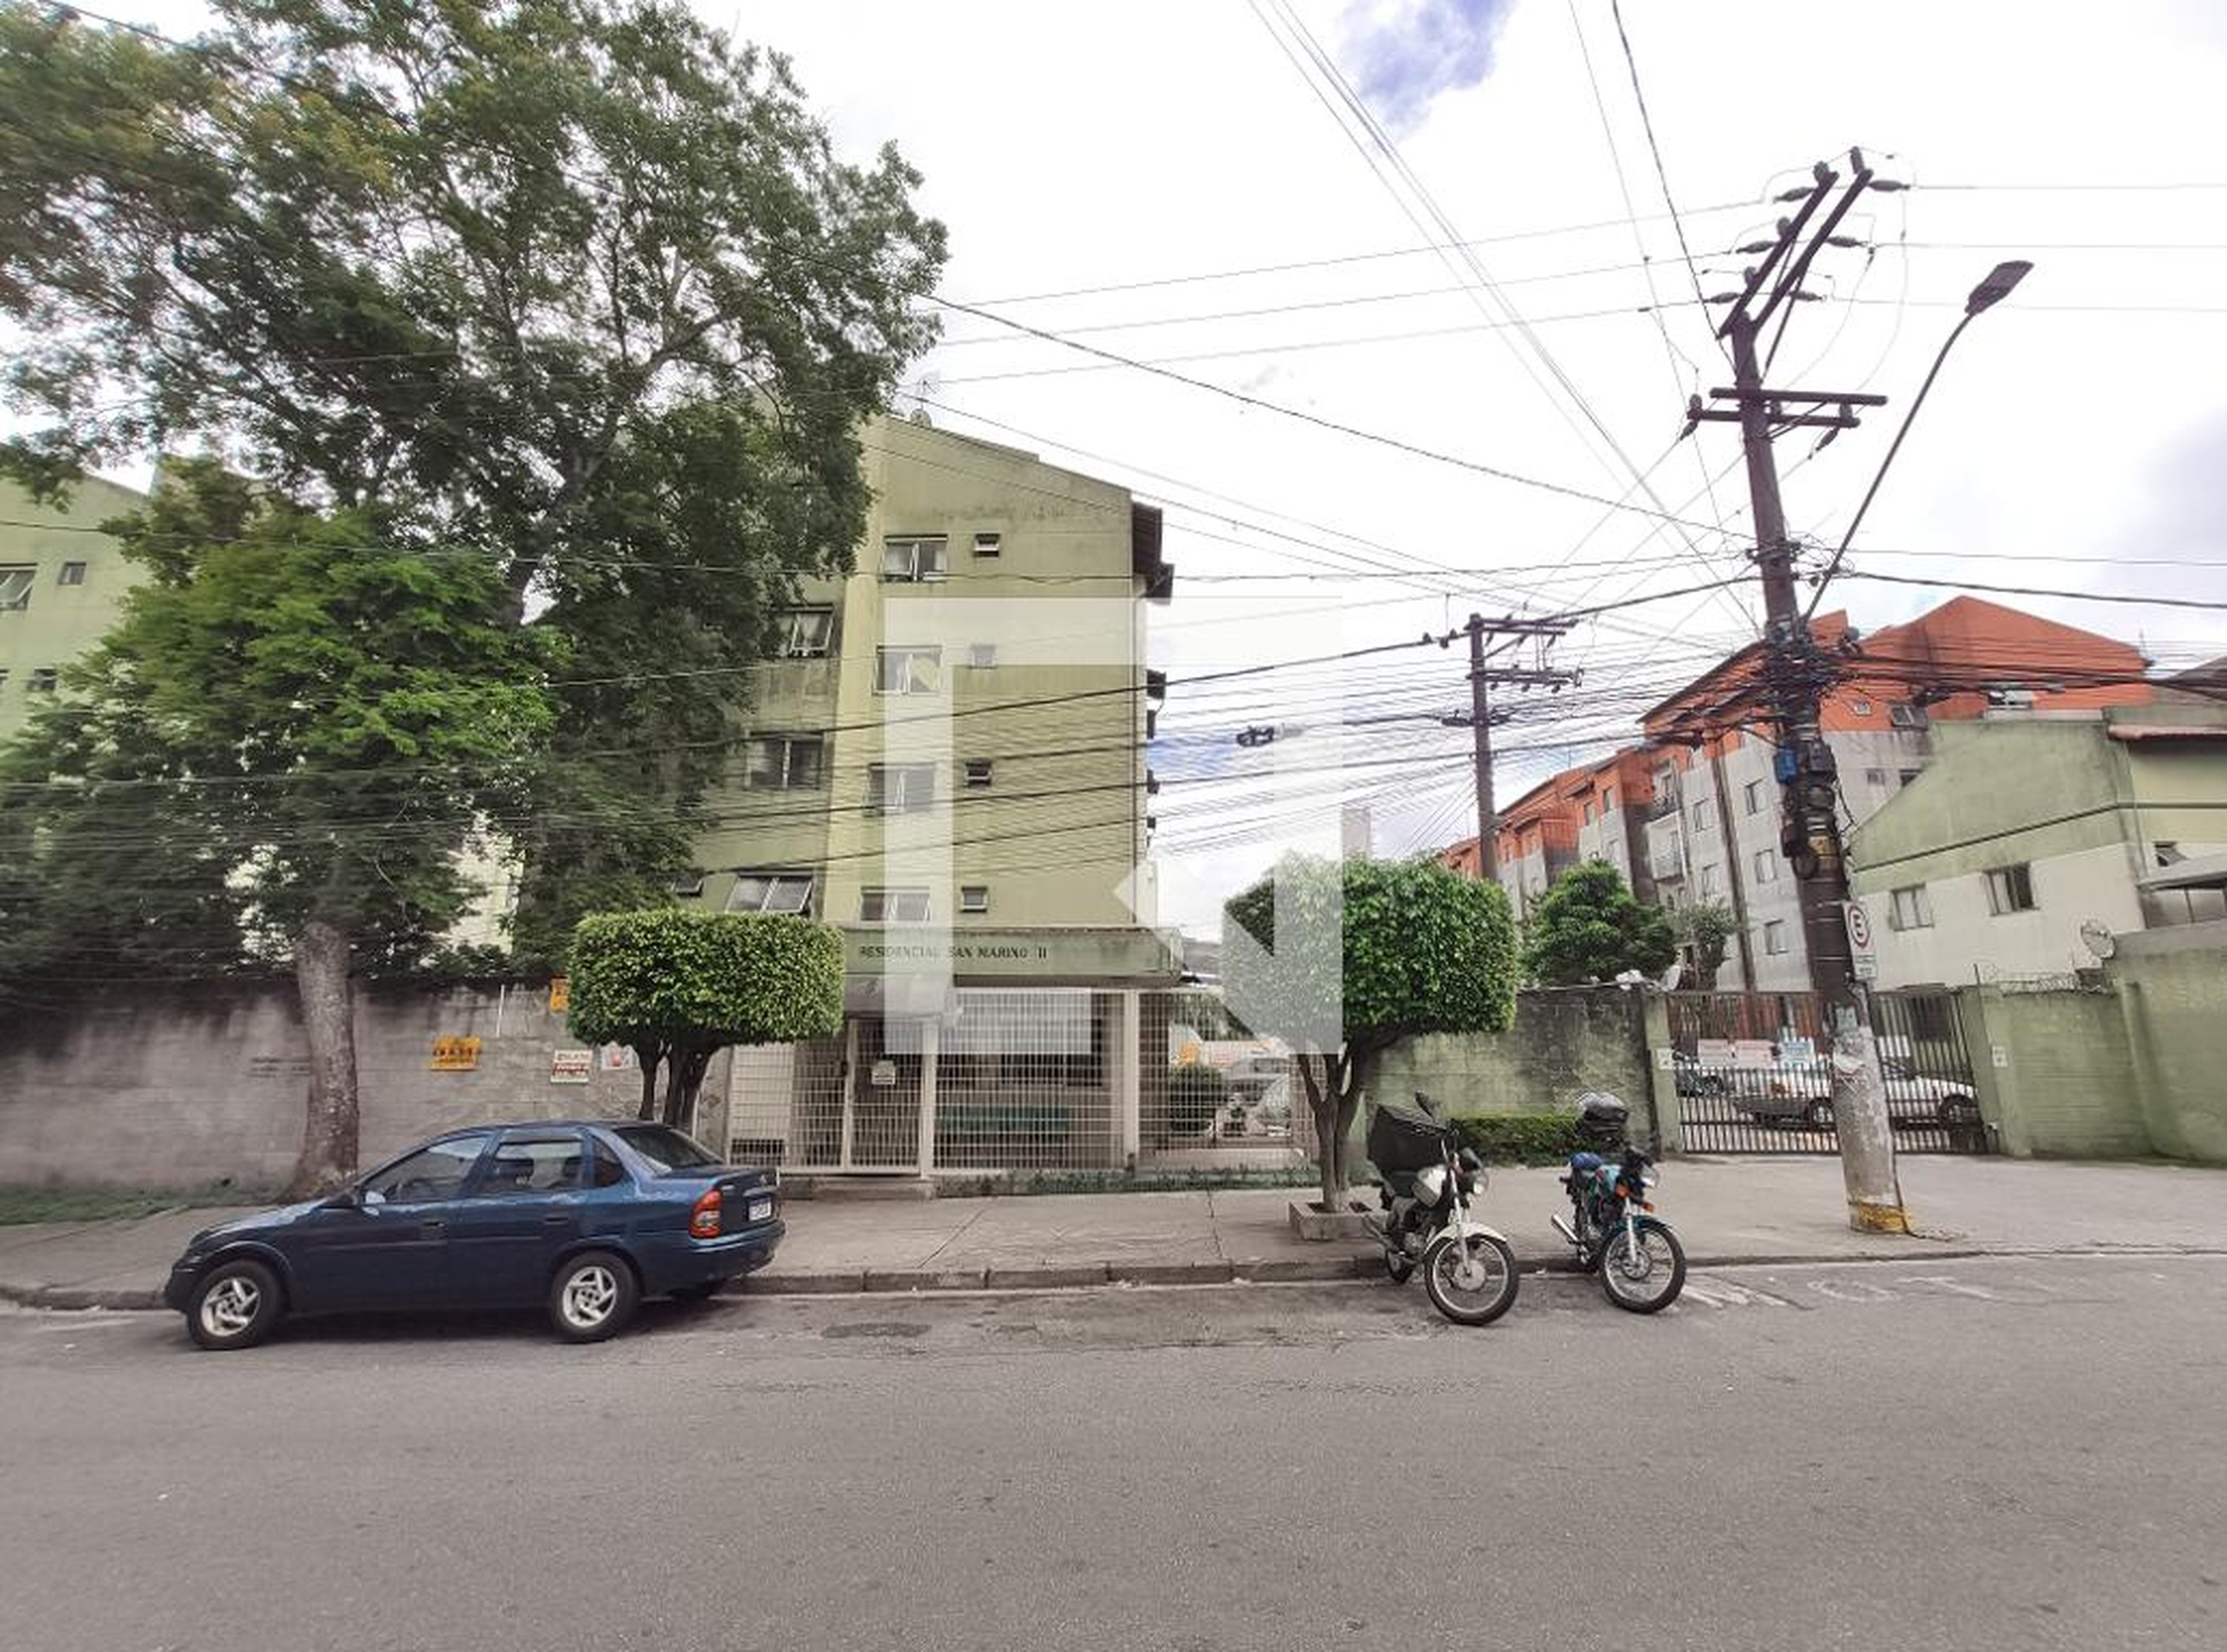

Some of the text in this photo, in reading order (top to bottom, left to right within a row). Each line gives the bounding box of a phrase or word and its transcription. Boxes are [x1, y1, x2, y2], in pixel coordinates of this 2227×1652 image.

[1853, 914, 1864, 938] E
[860, 946, 940, 958] RESIDENCIAL
[949, 946, 972, 958] SAN
[977, 946, 1027, 958] MARINO
